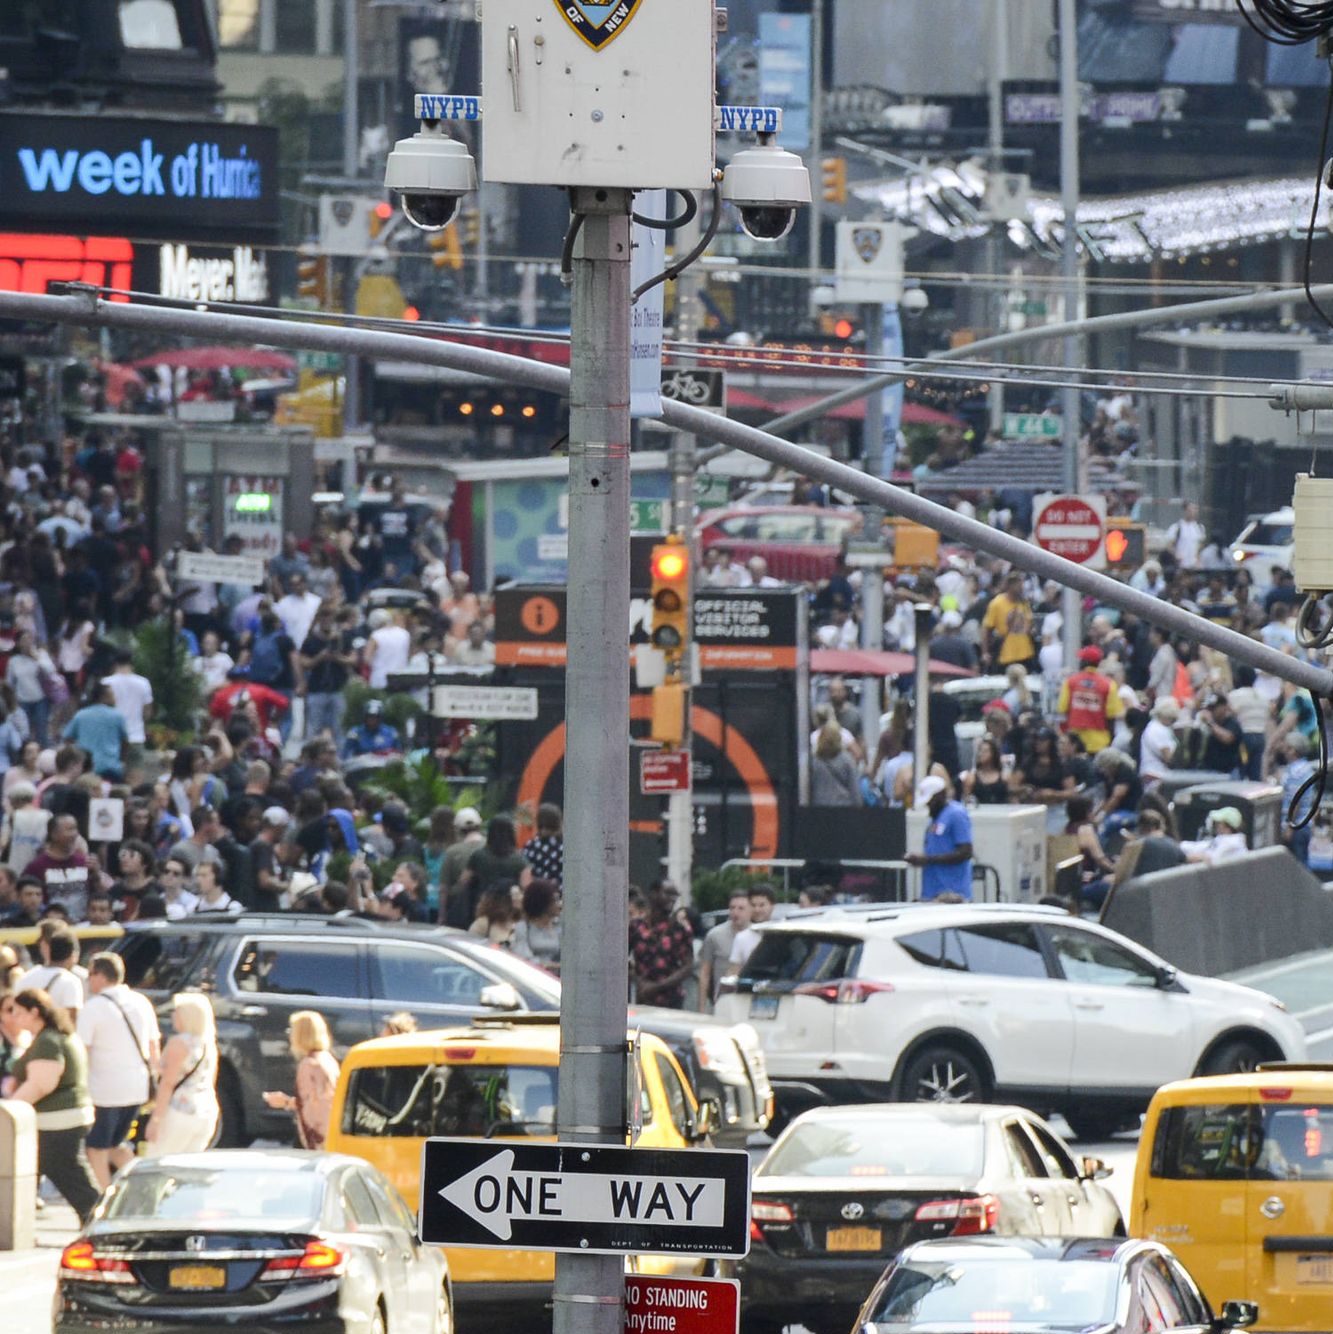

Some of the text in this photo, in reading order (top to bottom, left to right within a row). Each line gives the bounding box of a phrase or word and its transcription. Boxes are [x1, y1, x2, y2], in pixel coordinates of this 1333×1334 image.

[566, 3, 631, 33] OF NEW
[420, 96, 480, 121] NYPD
[720, 107, 778, 132] NYPD
[19, 139, 165, 196] week
[171, 149, 198, 198] of
[473, 1174, 706, 1222] ONE WAY
[659, 1242, 734, 1251] TRANSPORTATION
[624, 1286, 709, 1310] NO STANDING
[623, 1312, 677, 1334] Anytime
